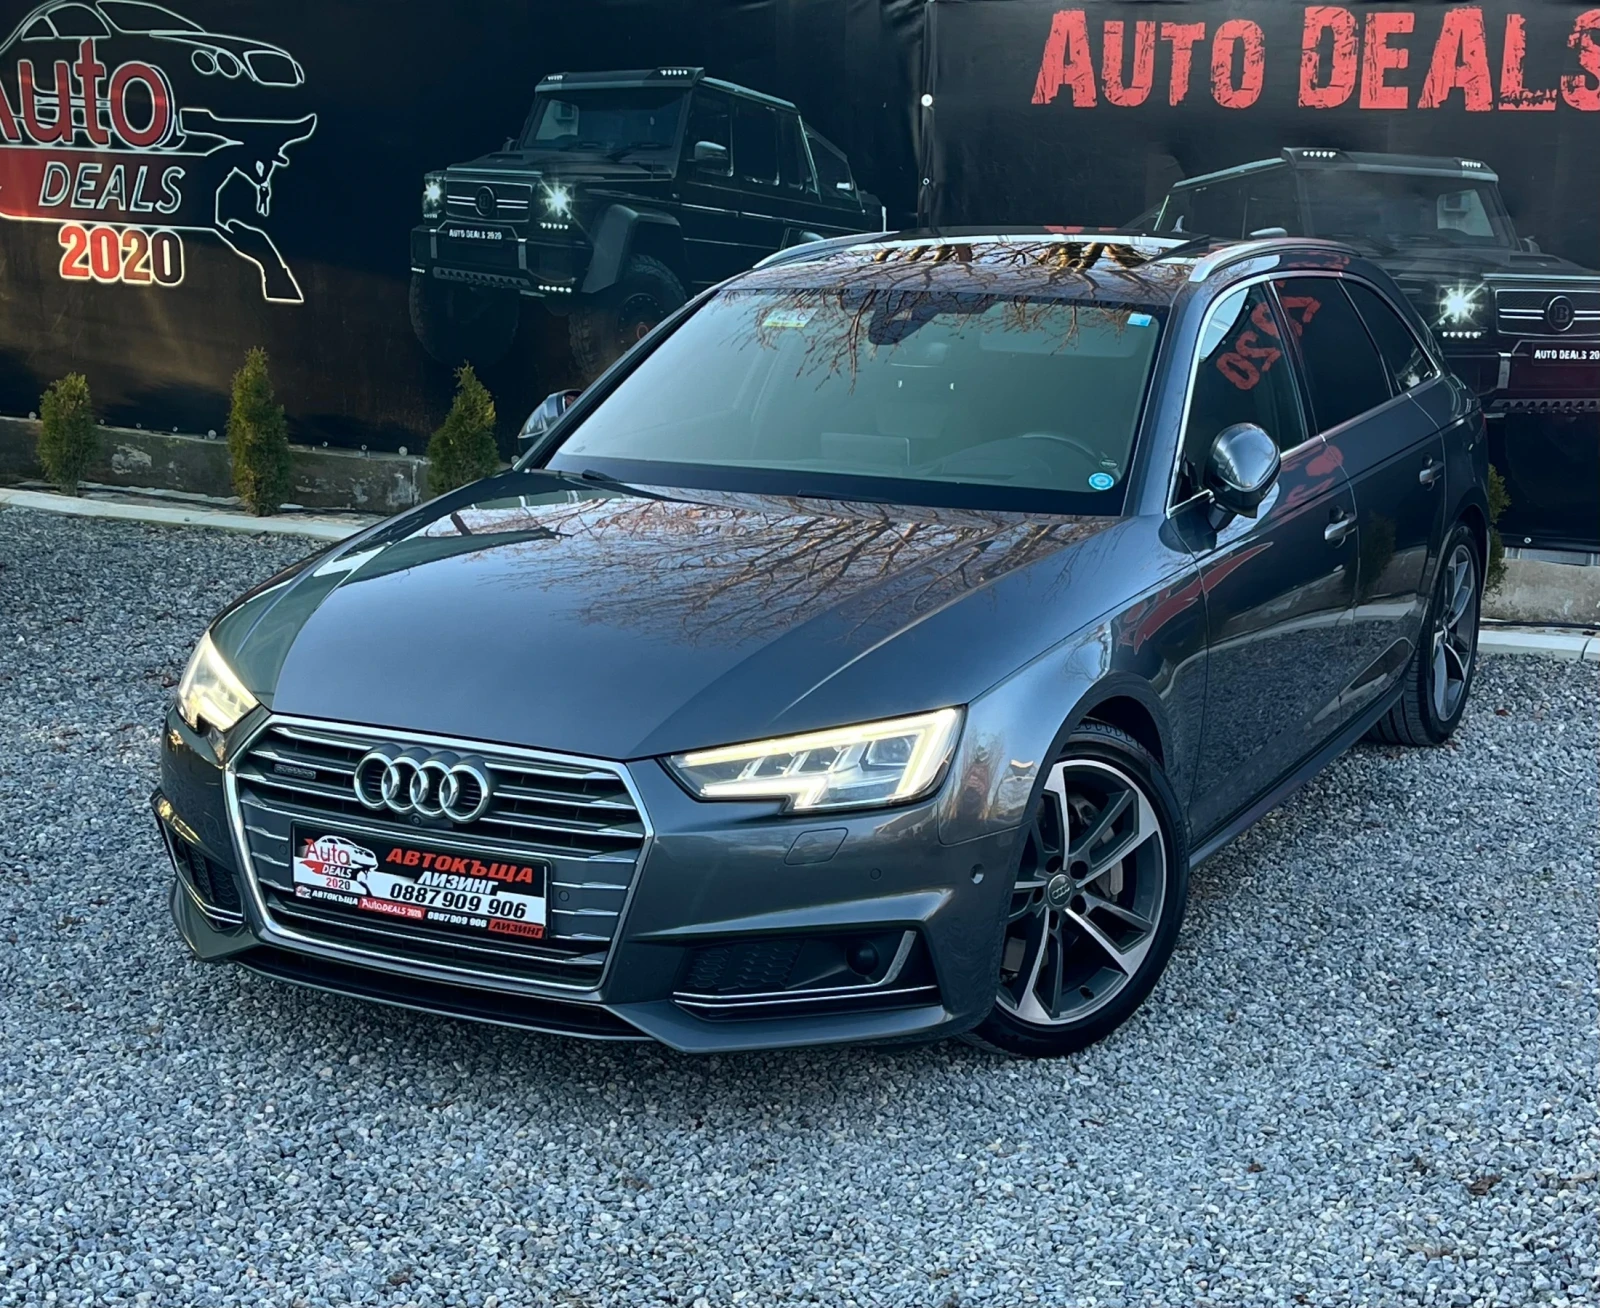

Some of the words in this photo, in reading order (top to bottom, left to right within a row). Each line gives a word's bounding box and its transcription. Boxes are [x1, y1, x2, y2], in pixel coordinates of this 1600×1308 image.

[1031, 9, 1265, 109] AUTO
[1298, 5, 1600, 112] DEALS
[38, 161, 186, 214] DEALS
[449, 229, 465, 238] AUTO
[466, 230, 486, 239] DEALS
[487, 231, 502, 240] 2020
[58, 223, 184, 287] 2020
[1534, 349, 1557, 360] AUTO
[1559, 350, 1587, 360] DEALS
[304, 838, 351, 866] Auto
[322, 865, 352, 878] DEALS
[386, 848, 533, 884] АВТОКЪЩА
[326, 877, 351, 891] 2020
[417, 871, 498, 895] ЛИЗИНГ
[312, 890, 358, 906] АВТОКЪЩА
[487, 898, 528, 919] 906
[469, 918, 488, 928] 906
[491, 919, 543, 939] ЛИЗИНГ
